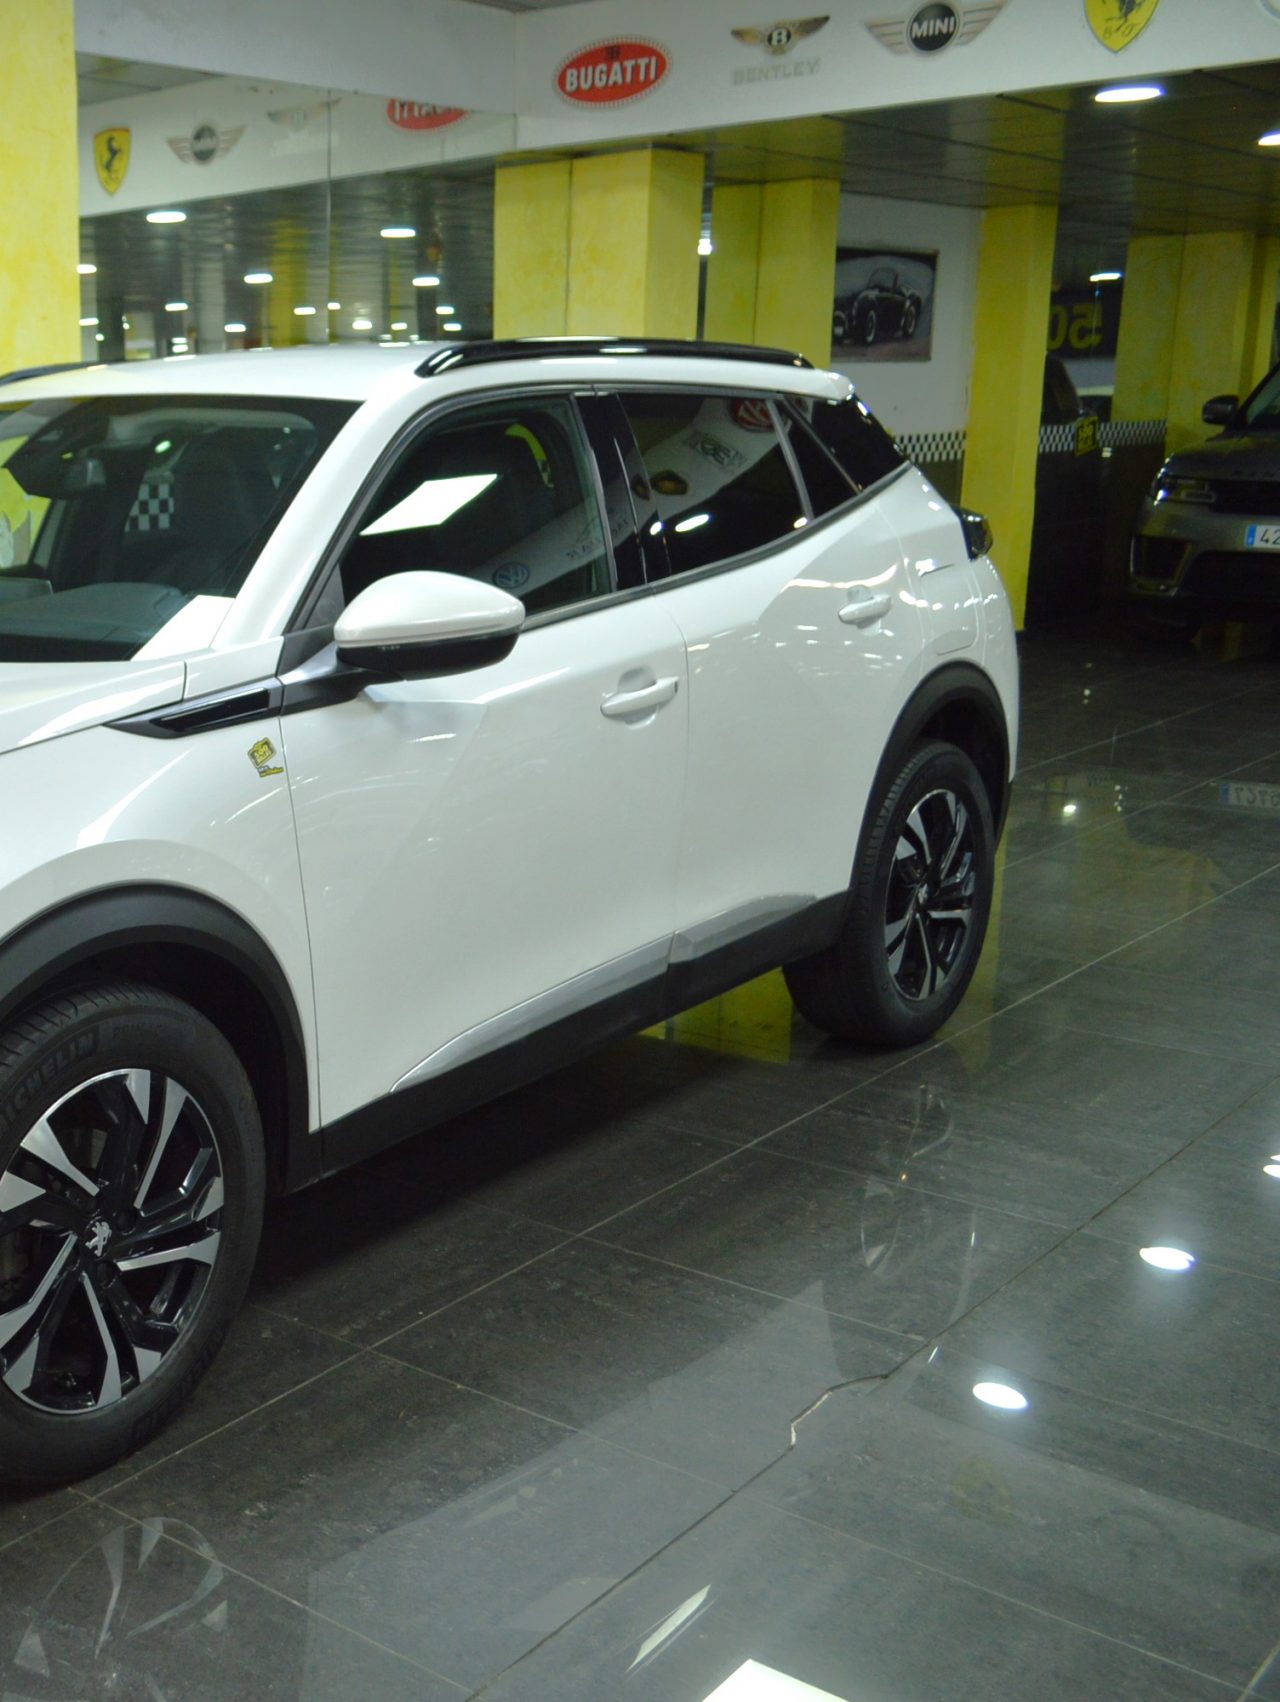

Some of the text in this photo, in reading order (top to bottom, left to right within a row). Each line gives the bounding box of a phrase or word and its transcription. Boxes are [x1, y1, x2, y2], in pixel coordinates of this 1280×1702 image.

[911, 16, 956, 39] MINI
[565, 56, 657, 93] BUGATTI
[733, 58, 819, 86] BENTLEY
